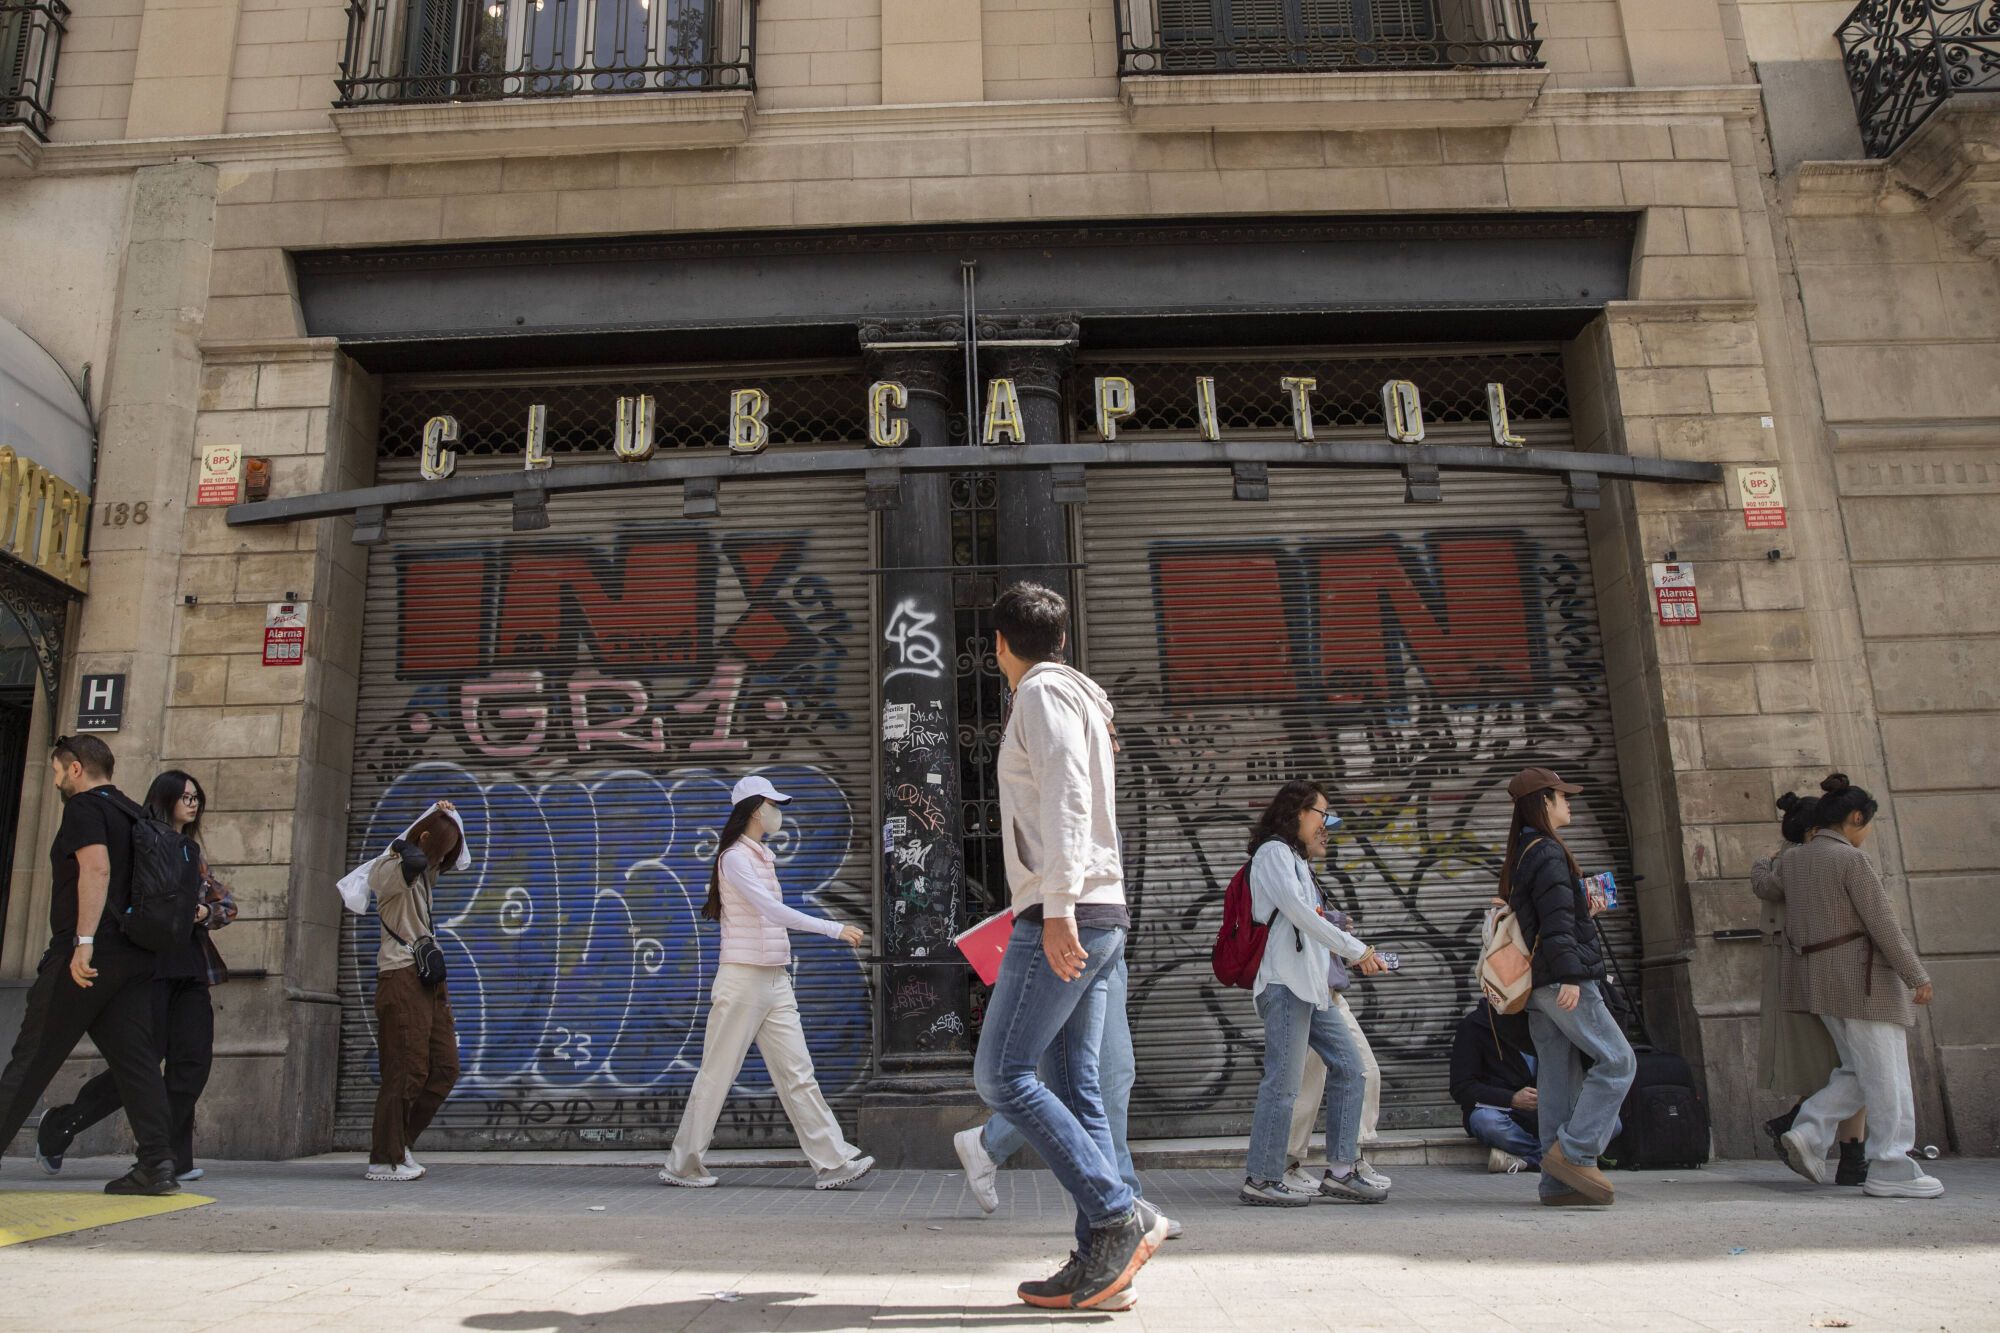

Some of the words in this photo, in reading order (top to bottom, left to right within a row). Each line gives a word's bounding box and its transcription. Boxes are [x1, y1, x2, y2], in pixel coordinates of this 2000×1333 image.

[420, 387, 770, 481] CLUB
[867, 376, 1527, 450] CAPITOL
[213, 456, 230, 465] BPS
[1750, 479, 1769, 488] BPS
[102, 500, 149, 527] 138
[1660, 588, 1694, 598] Alarma
[268, 629, 303, 638] Alarma
[88, 679, 114, 710] H
[553, 1026, 593, 1069] 23
